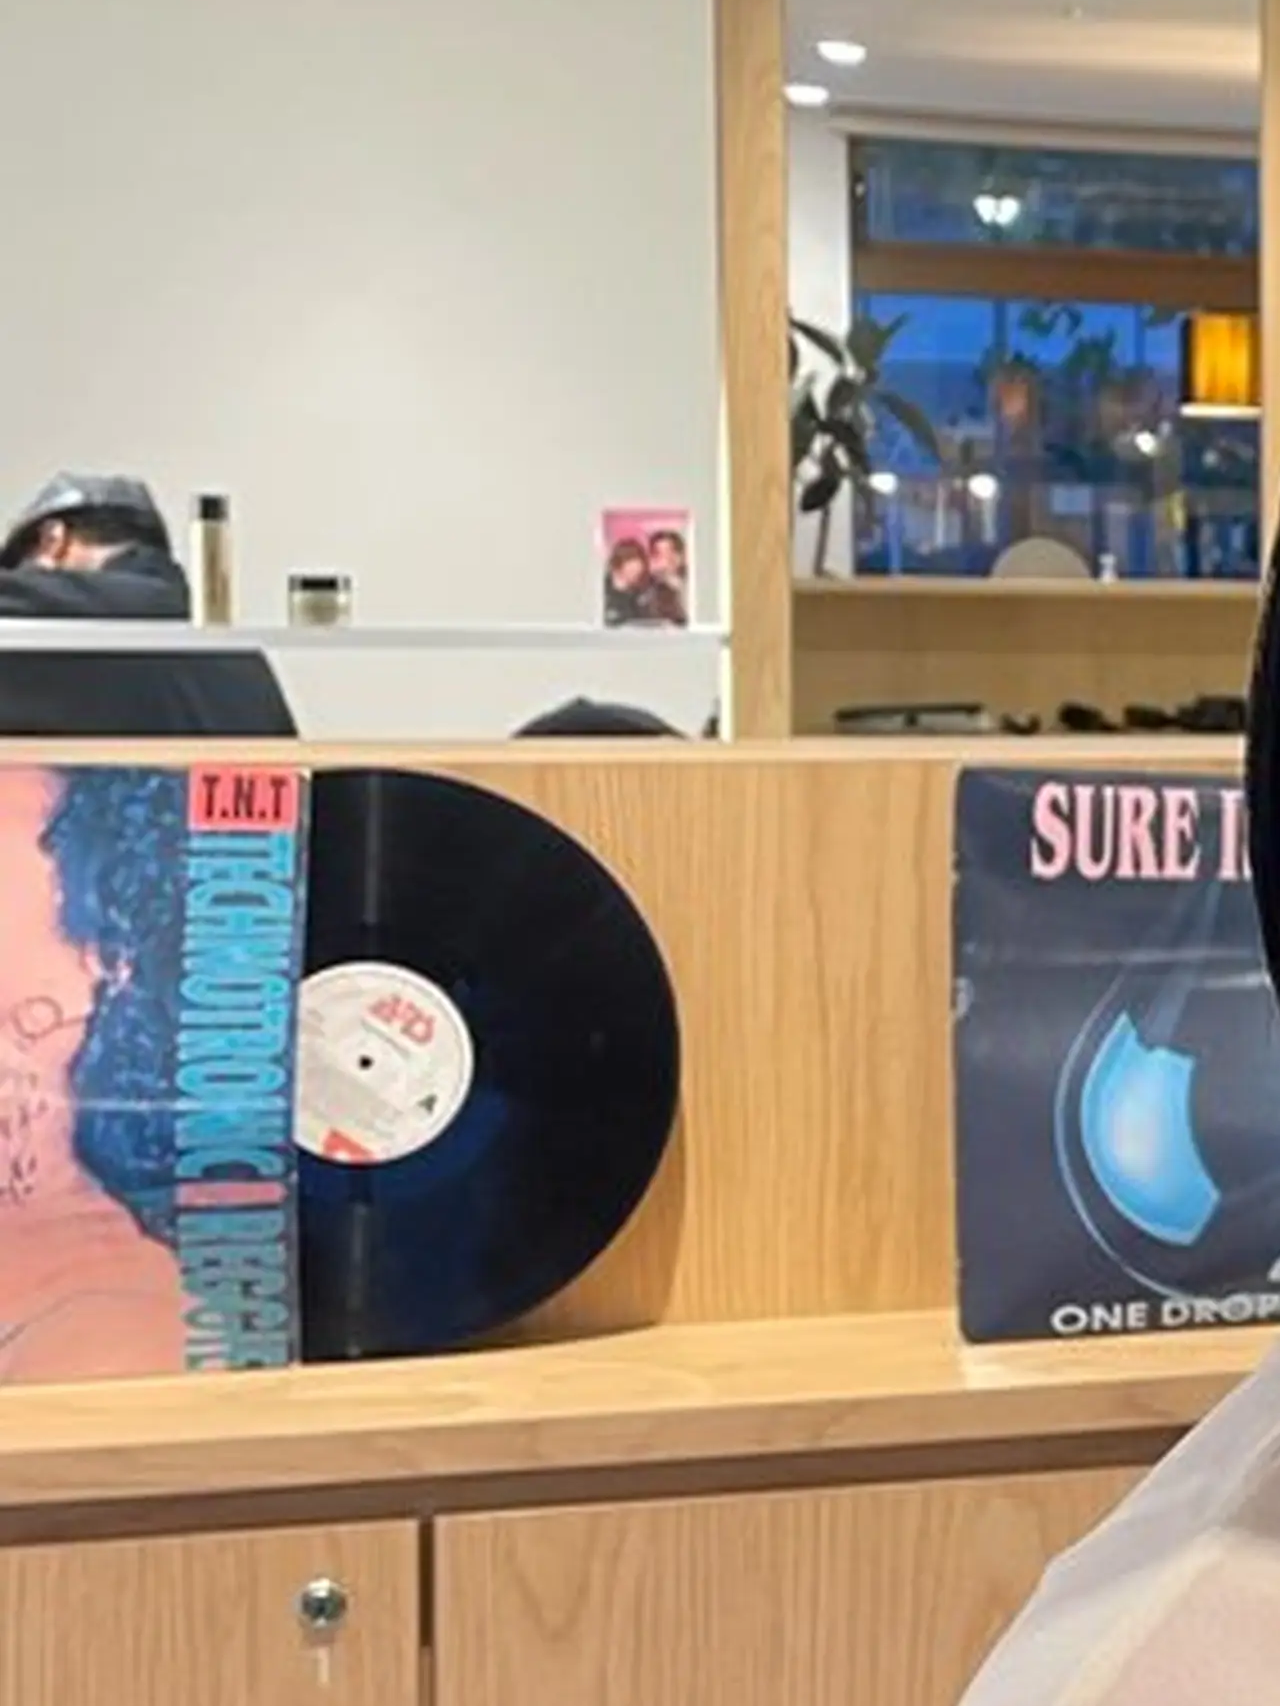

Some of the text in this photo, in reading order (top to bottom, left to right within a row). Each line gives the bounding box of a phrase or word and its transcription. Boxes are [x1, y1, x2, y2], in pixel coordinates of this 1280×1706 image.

[1030, 781, 1252, 881] SURE I
[176, 831, 295, 1180] TECHNOTRONIC
[1050, 1302, 1149, 1334] ONE
[1160, 1291, 1280, 1326] DROP
